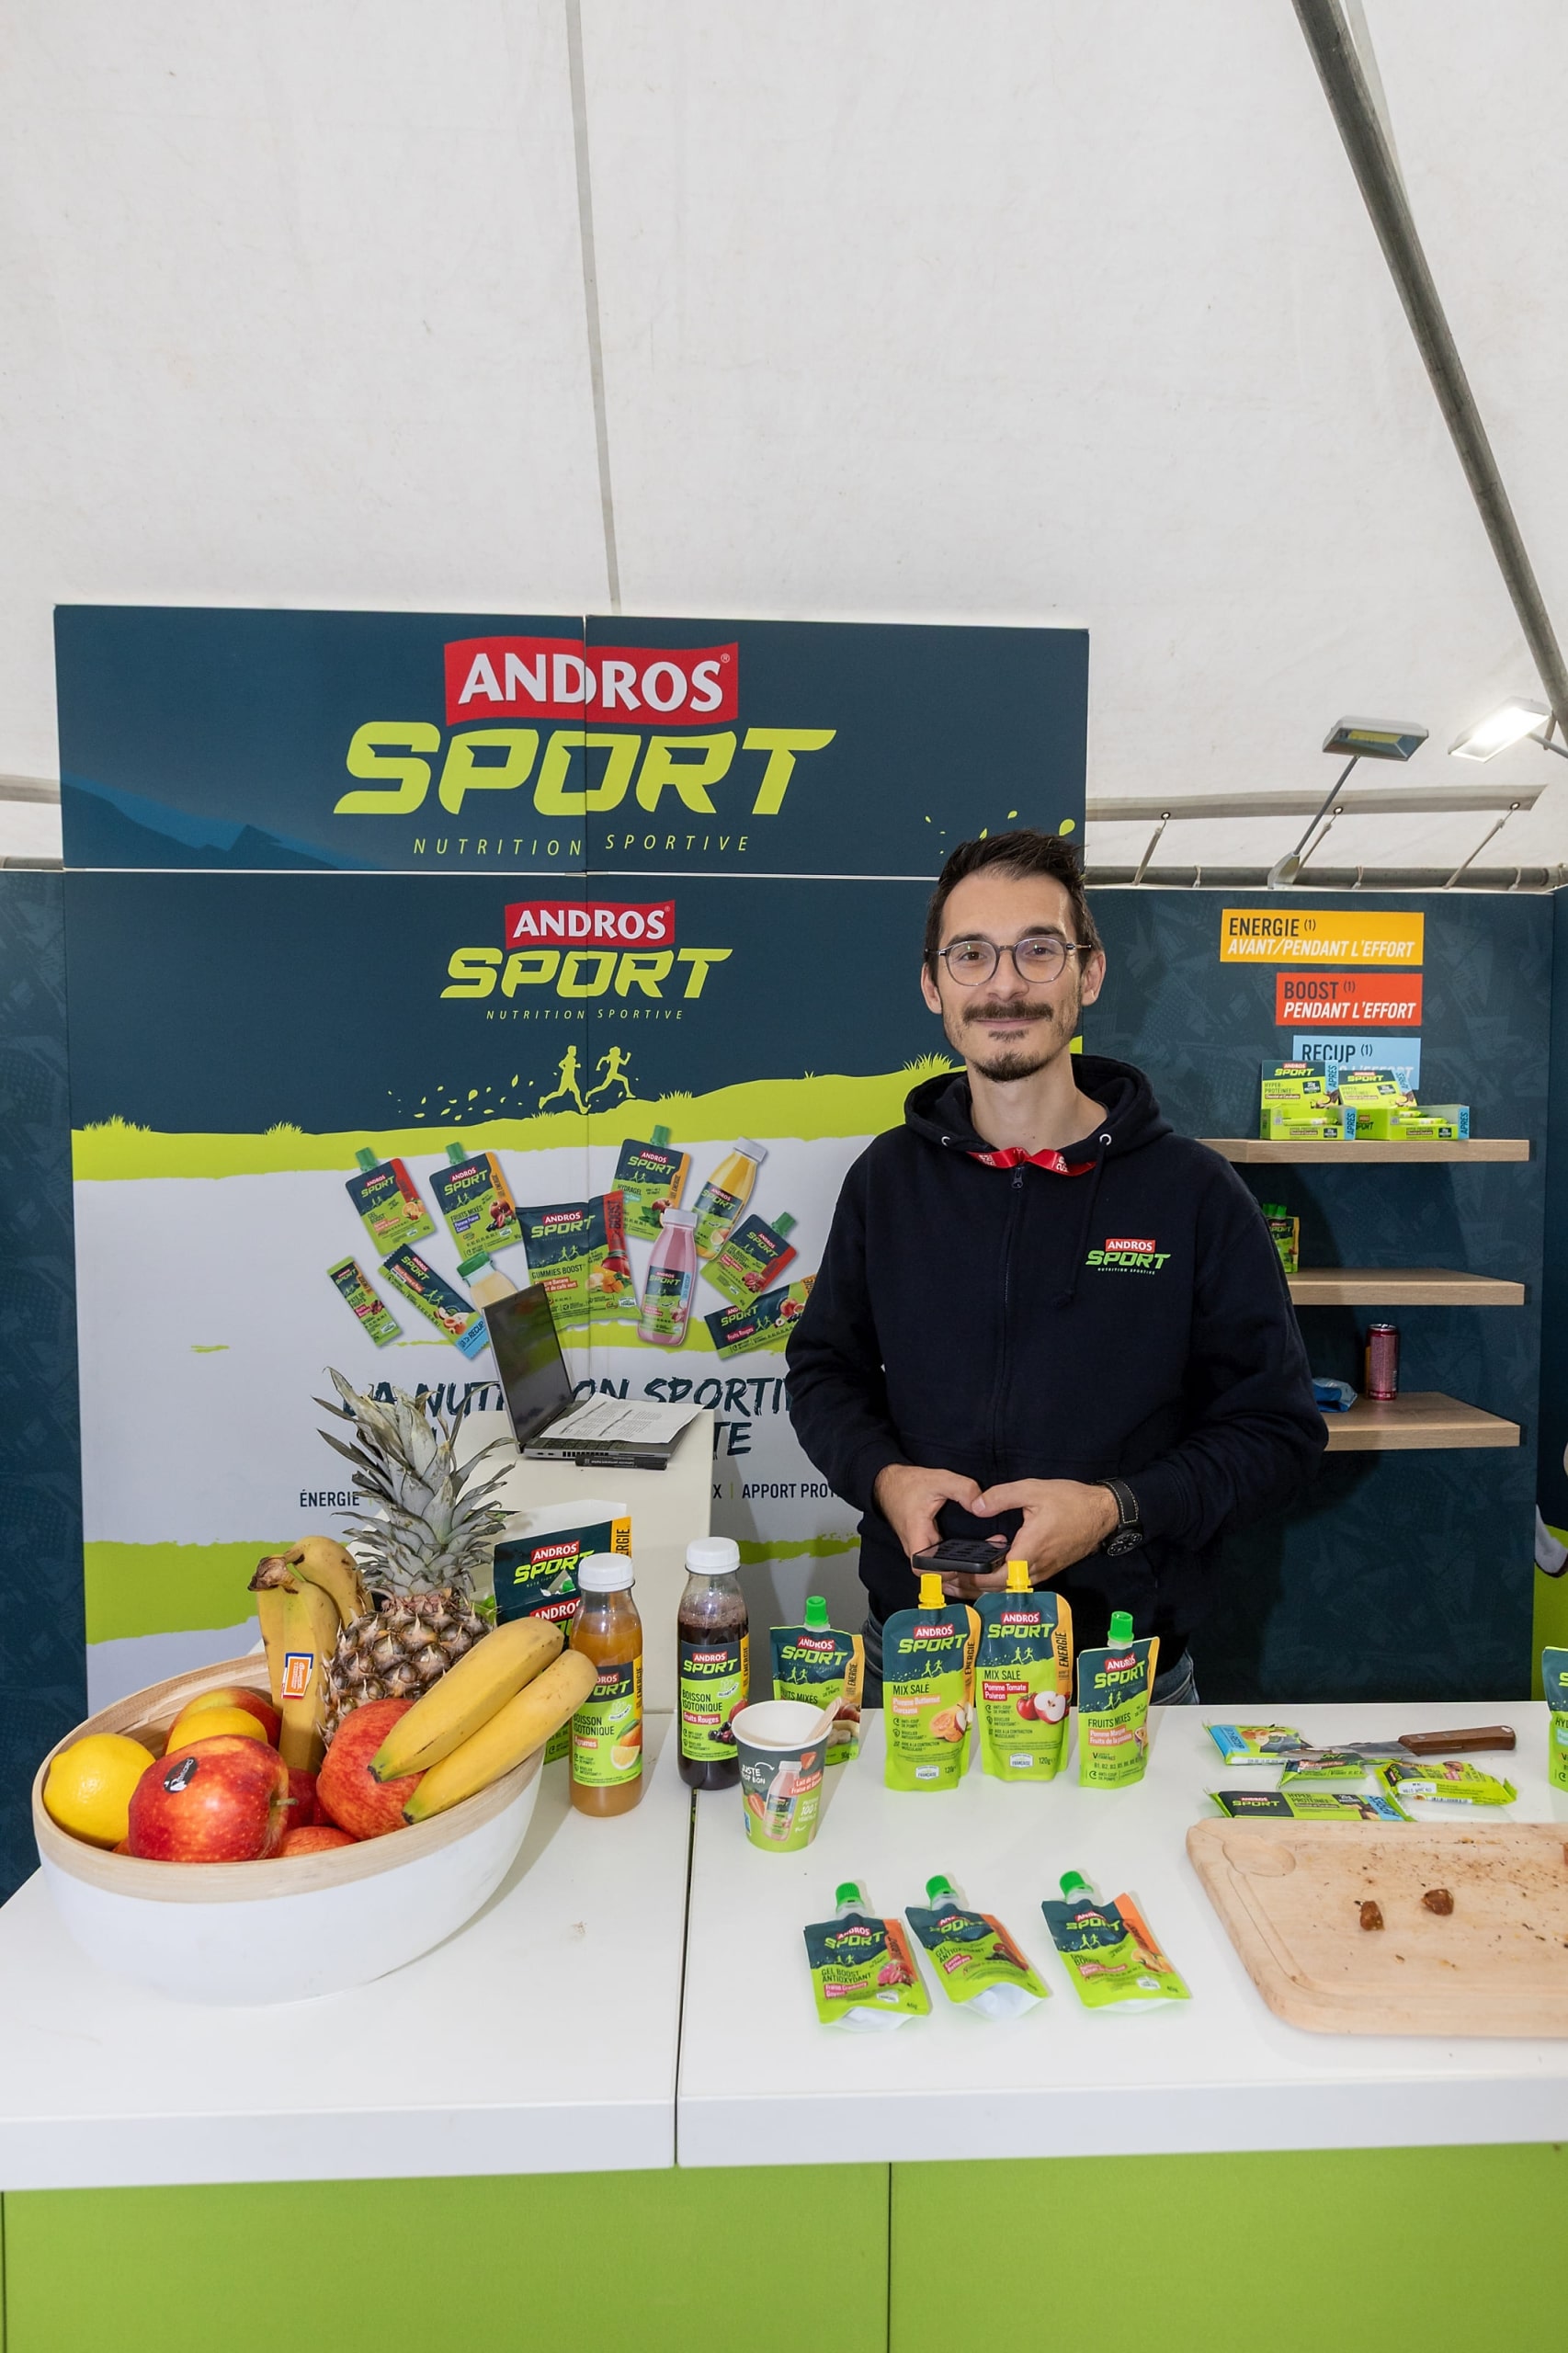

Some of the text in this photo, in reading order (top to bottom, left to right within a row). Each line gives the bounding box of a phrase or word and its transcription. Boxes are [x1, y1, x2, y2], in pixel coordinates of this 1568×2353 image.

[458, 653, 722, 712] ANDROS
[334, 722, 836, 816] SPORT
[414, 834, 750, 856] NUTRITION SPORTIVE
[513, 910, 666, 939] ANDROS
[1229, 917, 1300, 937] ENERGIE
[1228, 938, 1415, 958] AVANT/PENDANT L'EFFORT
[439, 948, 733, 998] SPORT
[1283, 981, 1339, 1000] BOOST
[487, 1008, 684, 1020] NUTRITION SPORTIVE
[1283, 1002, 1416, 1019] PENDANT L'EFFORT
[1301, 1043, 1356, 1063] RECUP
[1274, 1068, 1314, 1076] SPORT
[628, 1155, 676, 1176] SPORT
[641, 1152, 667, 1164] ANDROS
[444, 1169, 487, 1196] SPORT
[451, 1166, 476, 1182] ANDROS
[361, 1176, 394, 1198] SPORT
[701, 1188, 736, 1211] SPORT
[544, 1211, 582, 1224] ANDROS
[531, 1215, 596, 1239] SPORT
[746, 1231, 778, 1262] SPORT
[758, 1233, 777, 1249] ANDROS
[1107, 1241, 1153, 1251] ANDROS
[401, 1256, 430, 1280] SPORT
[1085, 1250, 1171, 1269] SPORT
[532, 1264, 583, 1279] GUMMIES BOOST
[649, 1275, 681, 1286] SPORT
[721, 1304, 758, 1326] SPORT
[301, 1488, 359, 1507] ÉNERGIE
[742, 1483, 797, 1499] APPORT
[533, 1542, 578, 1562] ANDROS
[1004, 1614, 1040, 1623] ANDROS
[915, 1626, 953, 1637] ANDROS
[987, 1623, 1055, 1638] SPORT
[799, 1638, 833, 1650] ANDROS
[897, 1633, 968, 1654] SPORT
[1055, 1631, 1069, 1667] ENERGIE
[694, 1653, 726, 1662] ANDROS
[781, 1645, 847, 1665] SPORT
[965, 1642, 975, 1675] ENERGIE
[1107, 1655, 1136, 1670] ANDROS
[683, 1657, 738, 1675] SPORT
[847, 1663, 858, 1687] ENERGIE
[984, 1668, 1021, 1680] MIX SALÉ
[1094, 1660, 1146, 1689] SPORT
[593, 1679, 631, 1696] ORT
[682, 1689, 711, 1702] BOISSON
[893, 1682, 929, 1695] MIX SALÉ
[984, 1683, 1027, 1691] Pomme Tomate
[682, 1700, 722, 1712] ISOTONIQUE
[574, 1712, 602, 1726] BOISSON
[698, 1715, 719, 1725] Rouges
[1088, 1718, 1114, 1728] FRUITS
[824, 1930, 884, 1949] SPORT
